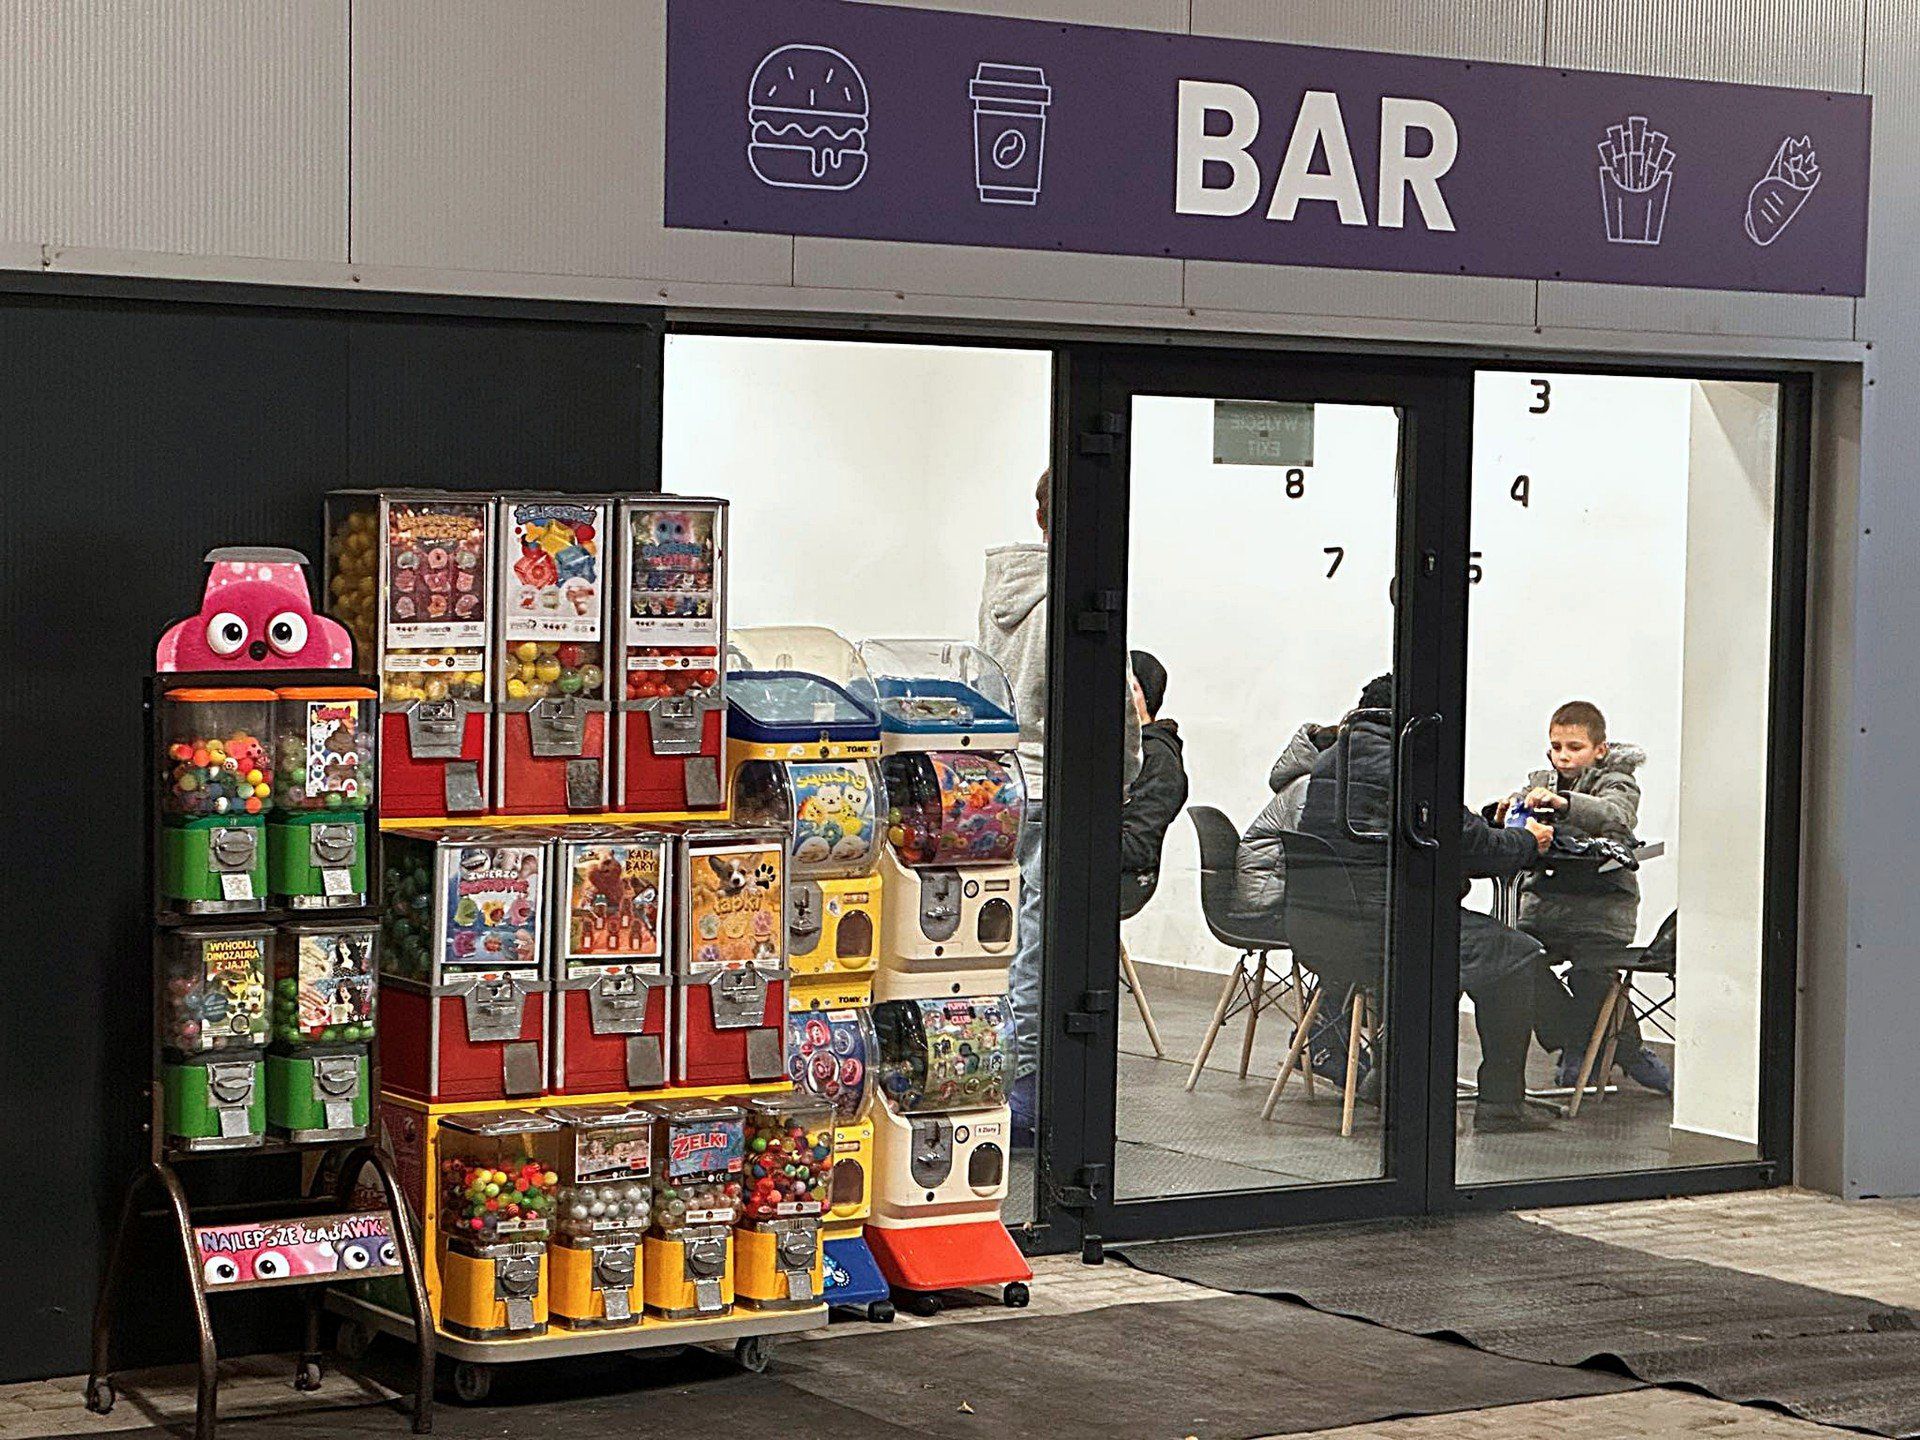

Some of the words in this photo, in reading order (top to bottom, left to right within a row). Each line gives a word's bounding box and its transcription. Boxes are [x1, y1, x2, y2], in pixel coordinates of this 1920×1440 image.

[1176, 80, 1458, 231] BAR
[1529, 379, 1551, 414] 3
[1286, 468, 1305, 499] 8
[1511, 474, 1529, 508] 4
[1323, 546, 1344, 579] 7
[625, 860, 655, 871] BARY
[628, 849, 653, 860] KAPI
[206, 949, 260, 961] DINOZAURA
[671, 1132, 728, 1161] ŻELKI
